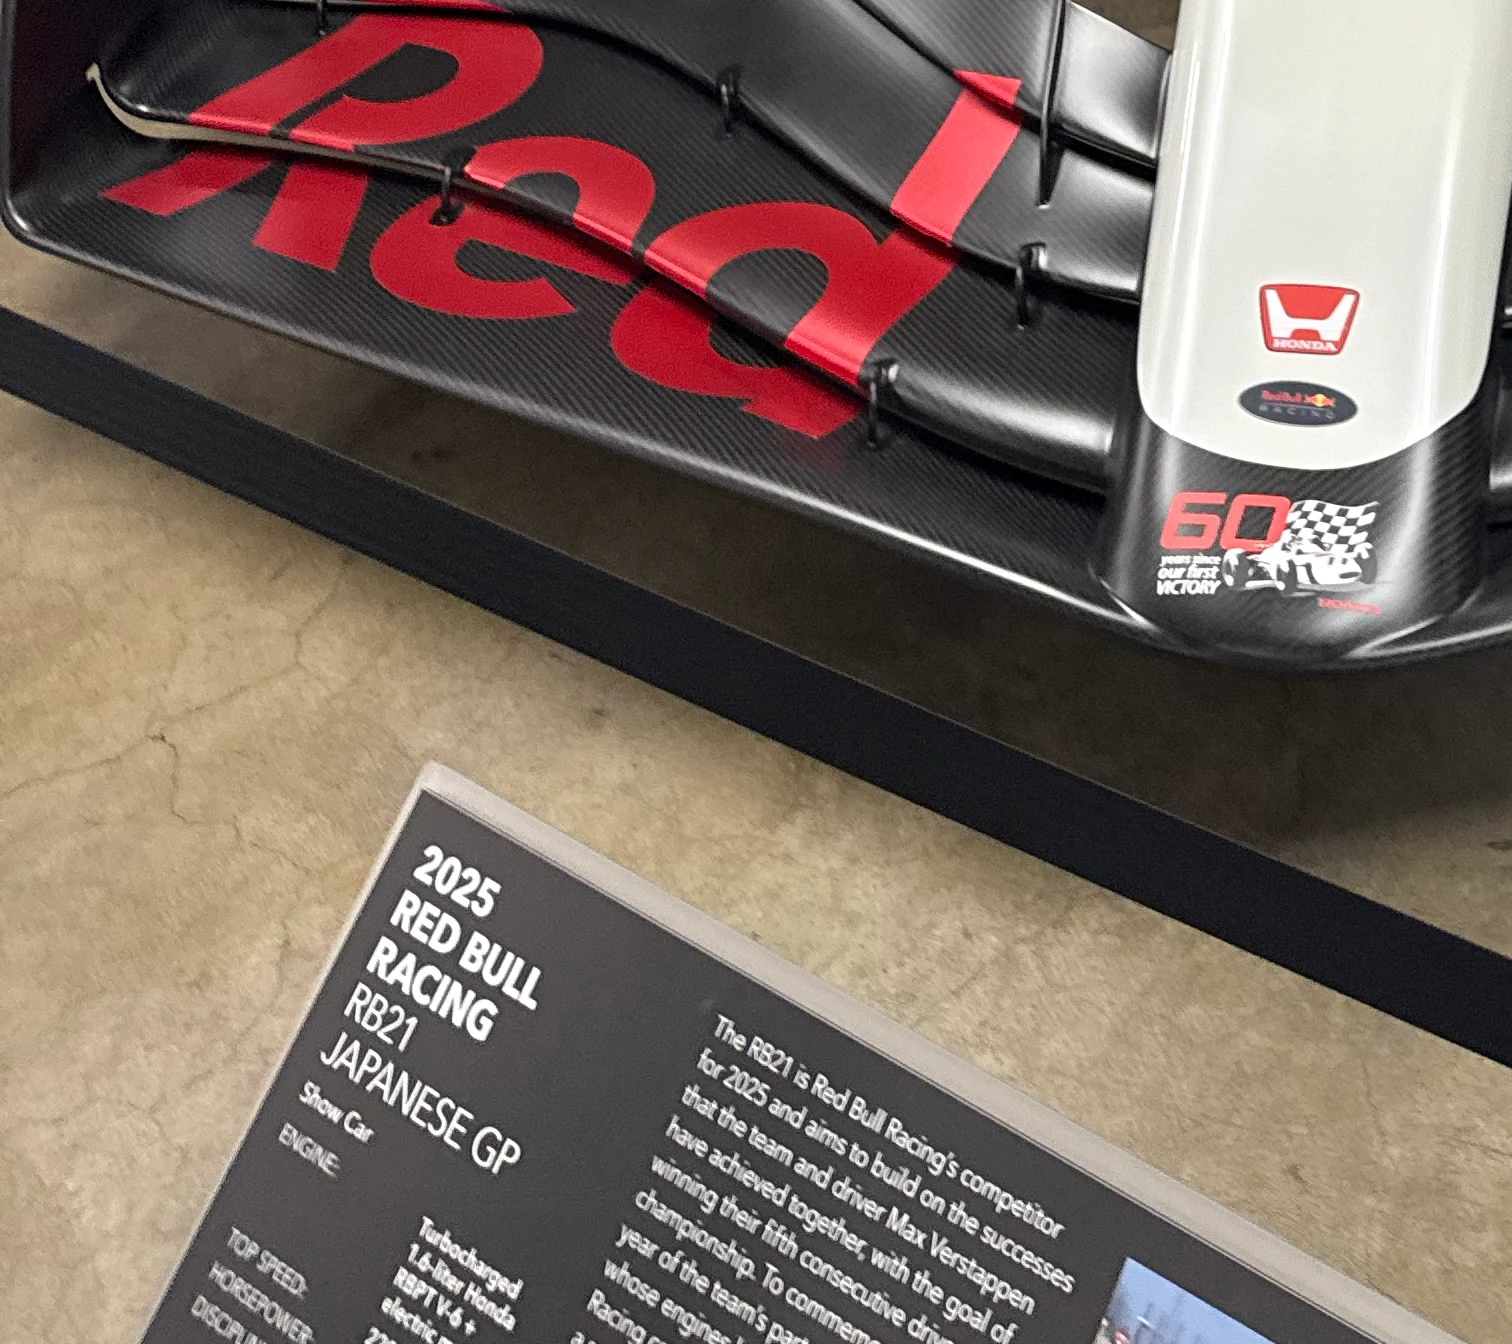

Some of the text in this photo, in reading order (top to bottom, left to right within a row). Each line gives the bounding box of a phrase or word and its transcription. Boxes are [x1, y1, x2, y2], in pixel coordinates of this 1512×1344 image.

[1160, 490, 1293, 553] 60
[1156, 579, 1223, 596] VICTORY
[412, 844, 501, 918] 2025
[365, 935, 498, 1041] RACING
[389, 888, 541, 1010] RED BULL
[343, 981, 418, 1052] RB21
[297, 1079, 375, 1143] Show Car
[319, 1031, 521, 1174] JAPANESE GP
[713, 1013, 1065, 1238] The RB21 is Red Bull Racing's competitor
[680, 1083, 1035, 1315] that the team and driver Max Verstappen
[696, 1046, 1075, 1293] for 2025 and aims to build on the successes
[412, 1215, 524, 1300] Turbocharged
[634, 1188, 756, 1280] championship.
[761, 1261, 785, 1296] To
[650, 1154, 719, 1214] winning
[718, 1194, 763, 1234] their
[760, 1217, 799, 1259] fifth
[798, 1249, 906, 1327] consecutive
[664, 1113, 1019, 1344] have achieved together, with the goal of
[380, 1295, 438, 1344] electric
[392, 1265, 439, 1308] RBPT
[435, 1293, 464, 1329] V-6
[462, 1280, 516, 1331] Honda
[586, 1288, 647, 1344] Racing
[603, 1258, 661, 1307] whose
[614, 1223, 660, 1258] year
[657, 1249, 685, 1273] of
[678, 1258, 710, 1294] the
[709, 1280, 769, 1332] team's
